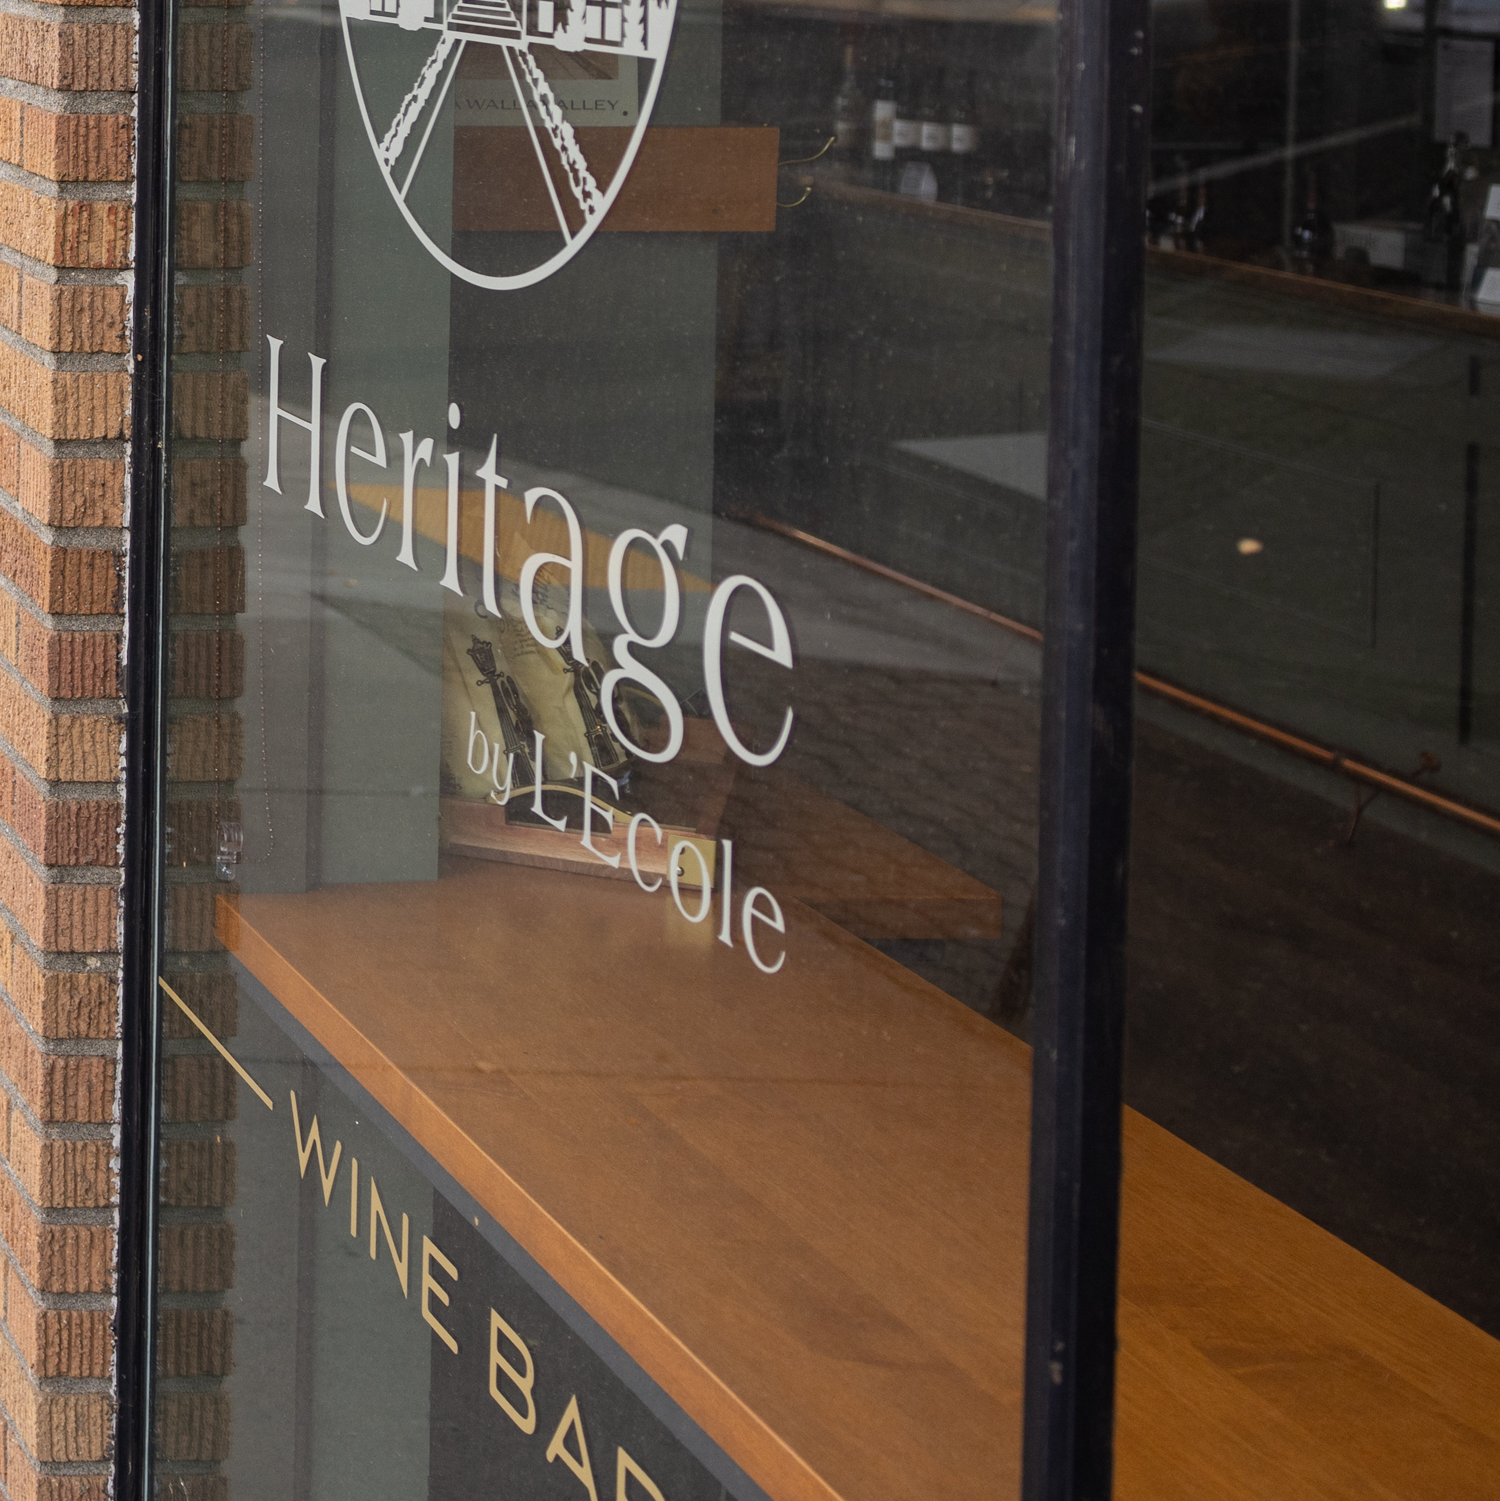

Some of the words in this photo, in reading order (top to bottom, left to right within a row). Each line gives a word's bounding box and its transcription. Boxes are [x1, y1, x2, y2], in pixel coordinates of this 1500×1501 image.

[263, 333, 795, 767] Heritage
[467, 711, 514, 806] by
[531, 731, 788, 974] L'Ecole
[290, 1090, 460, 1355] WINE
